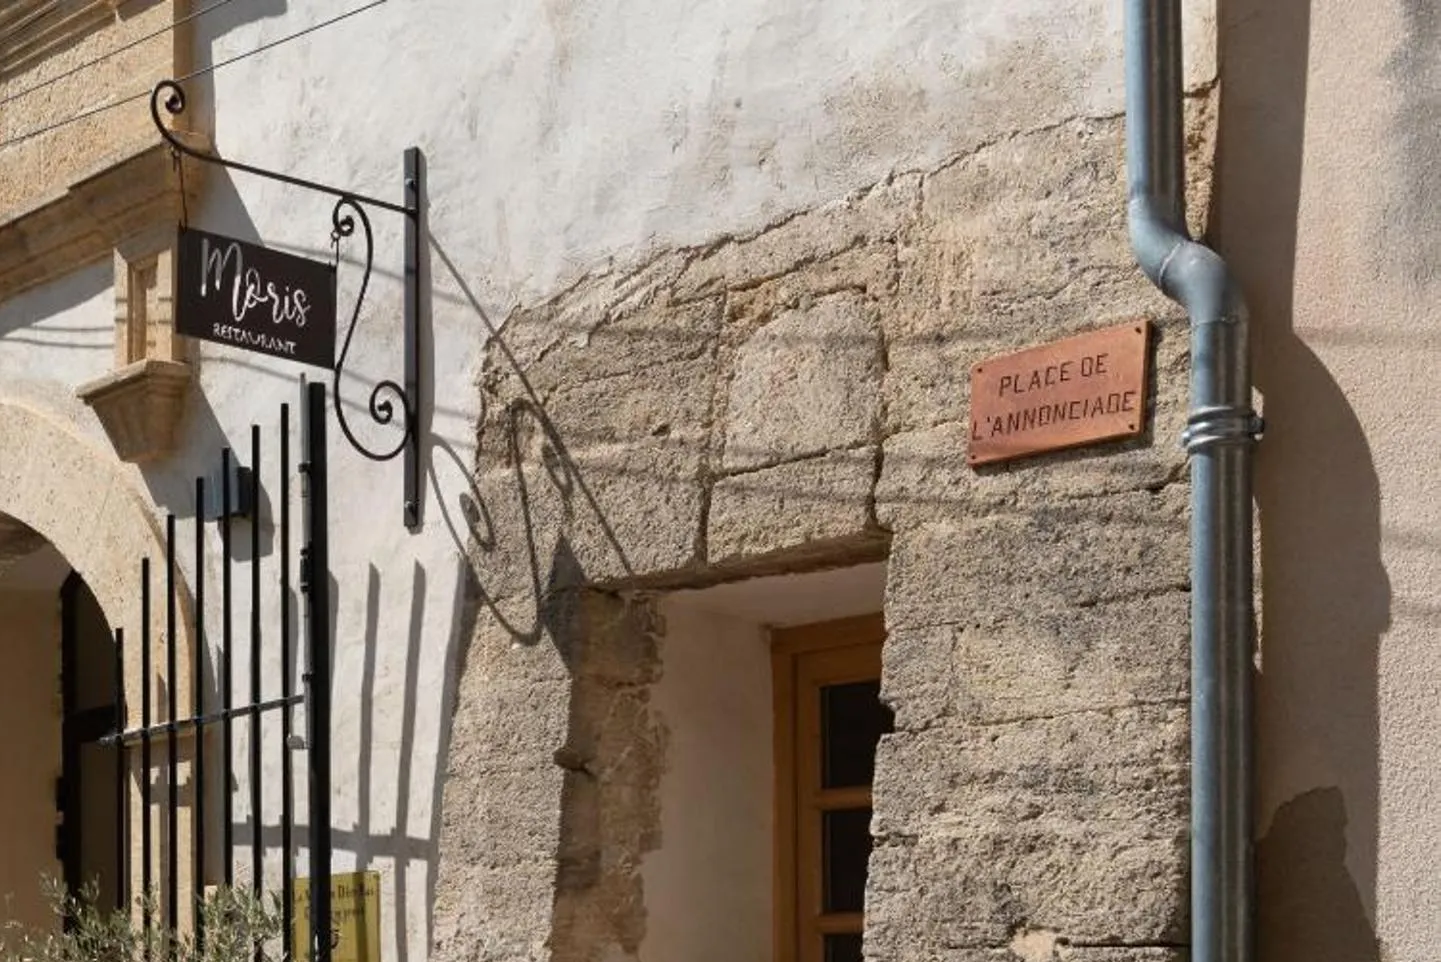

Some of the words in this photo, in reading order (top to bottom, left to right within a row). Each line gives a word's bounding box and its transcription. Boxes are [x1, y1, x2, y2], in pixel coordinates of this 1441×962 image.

[212, 322, 297, 354] RESTAURANT
[998, 360, 1074, 397] PLACE
[1081, 353, 1109, 377] DE
[971, 390, 1137, 440] L'ANNONCIADE
